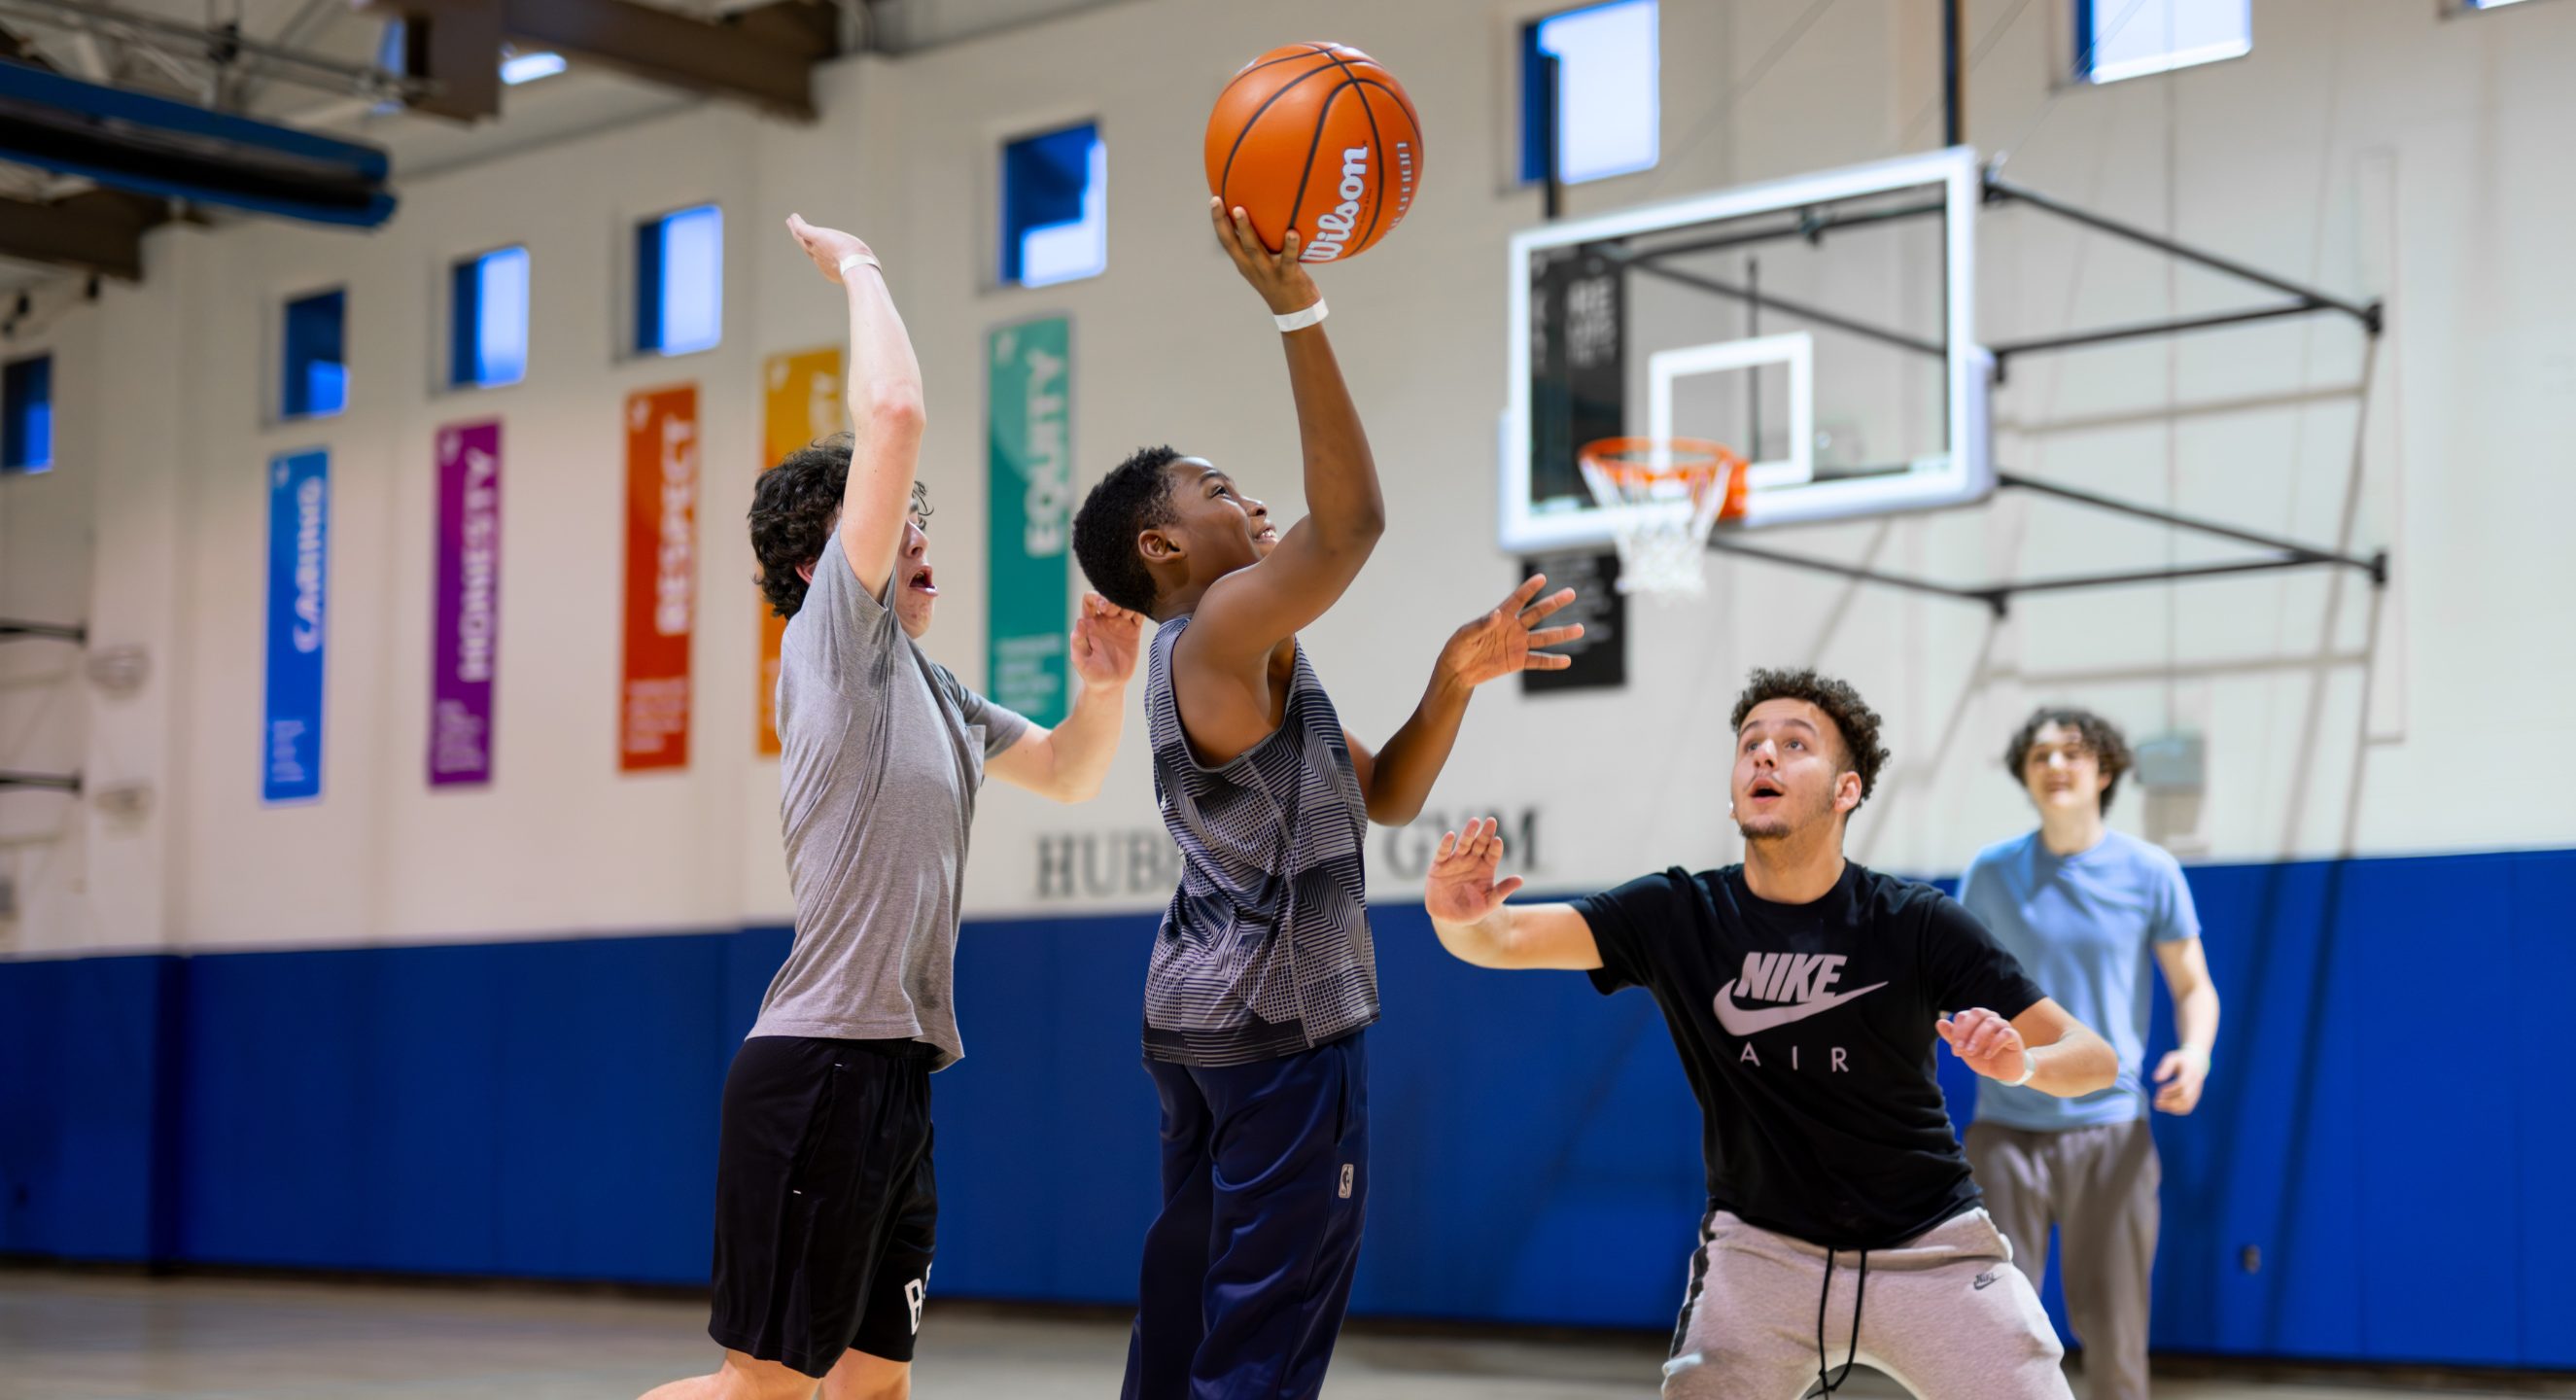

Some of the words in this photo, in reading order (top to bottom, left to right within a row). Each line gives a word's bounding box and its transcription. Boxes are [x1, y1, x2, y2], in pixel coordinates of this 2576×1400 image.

[1299, 146, 1369, 262] Wilson
[657, 414, 696, 635] RESPECT
[1024, 348, 1069, 557] EQUITY
[294, 474, 327, 653] CARING
[459, 447, 498, 682] HONESTY
[1733, 951, 1848, 1003] NIKE
[1740, 1040, 1849, 1073] AIR
